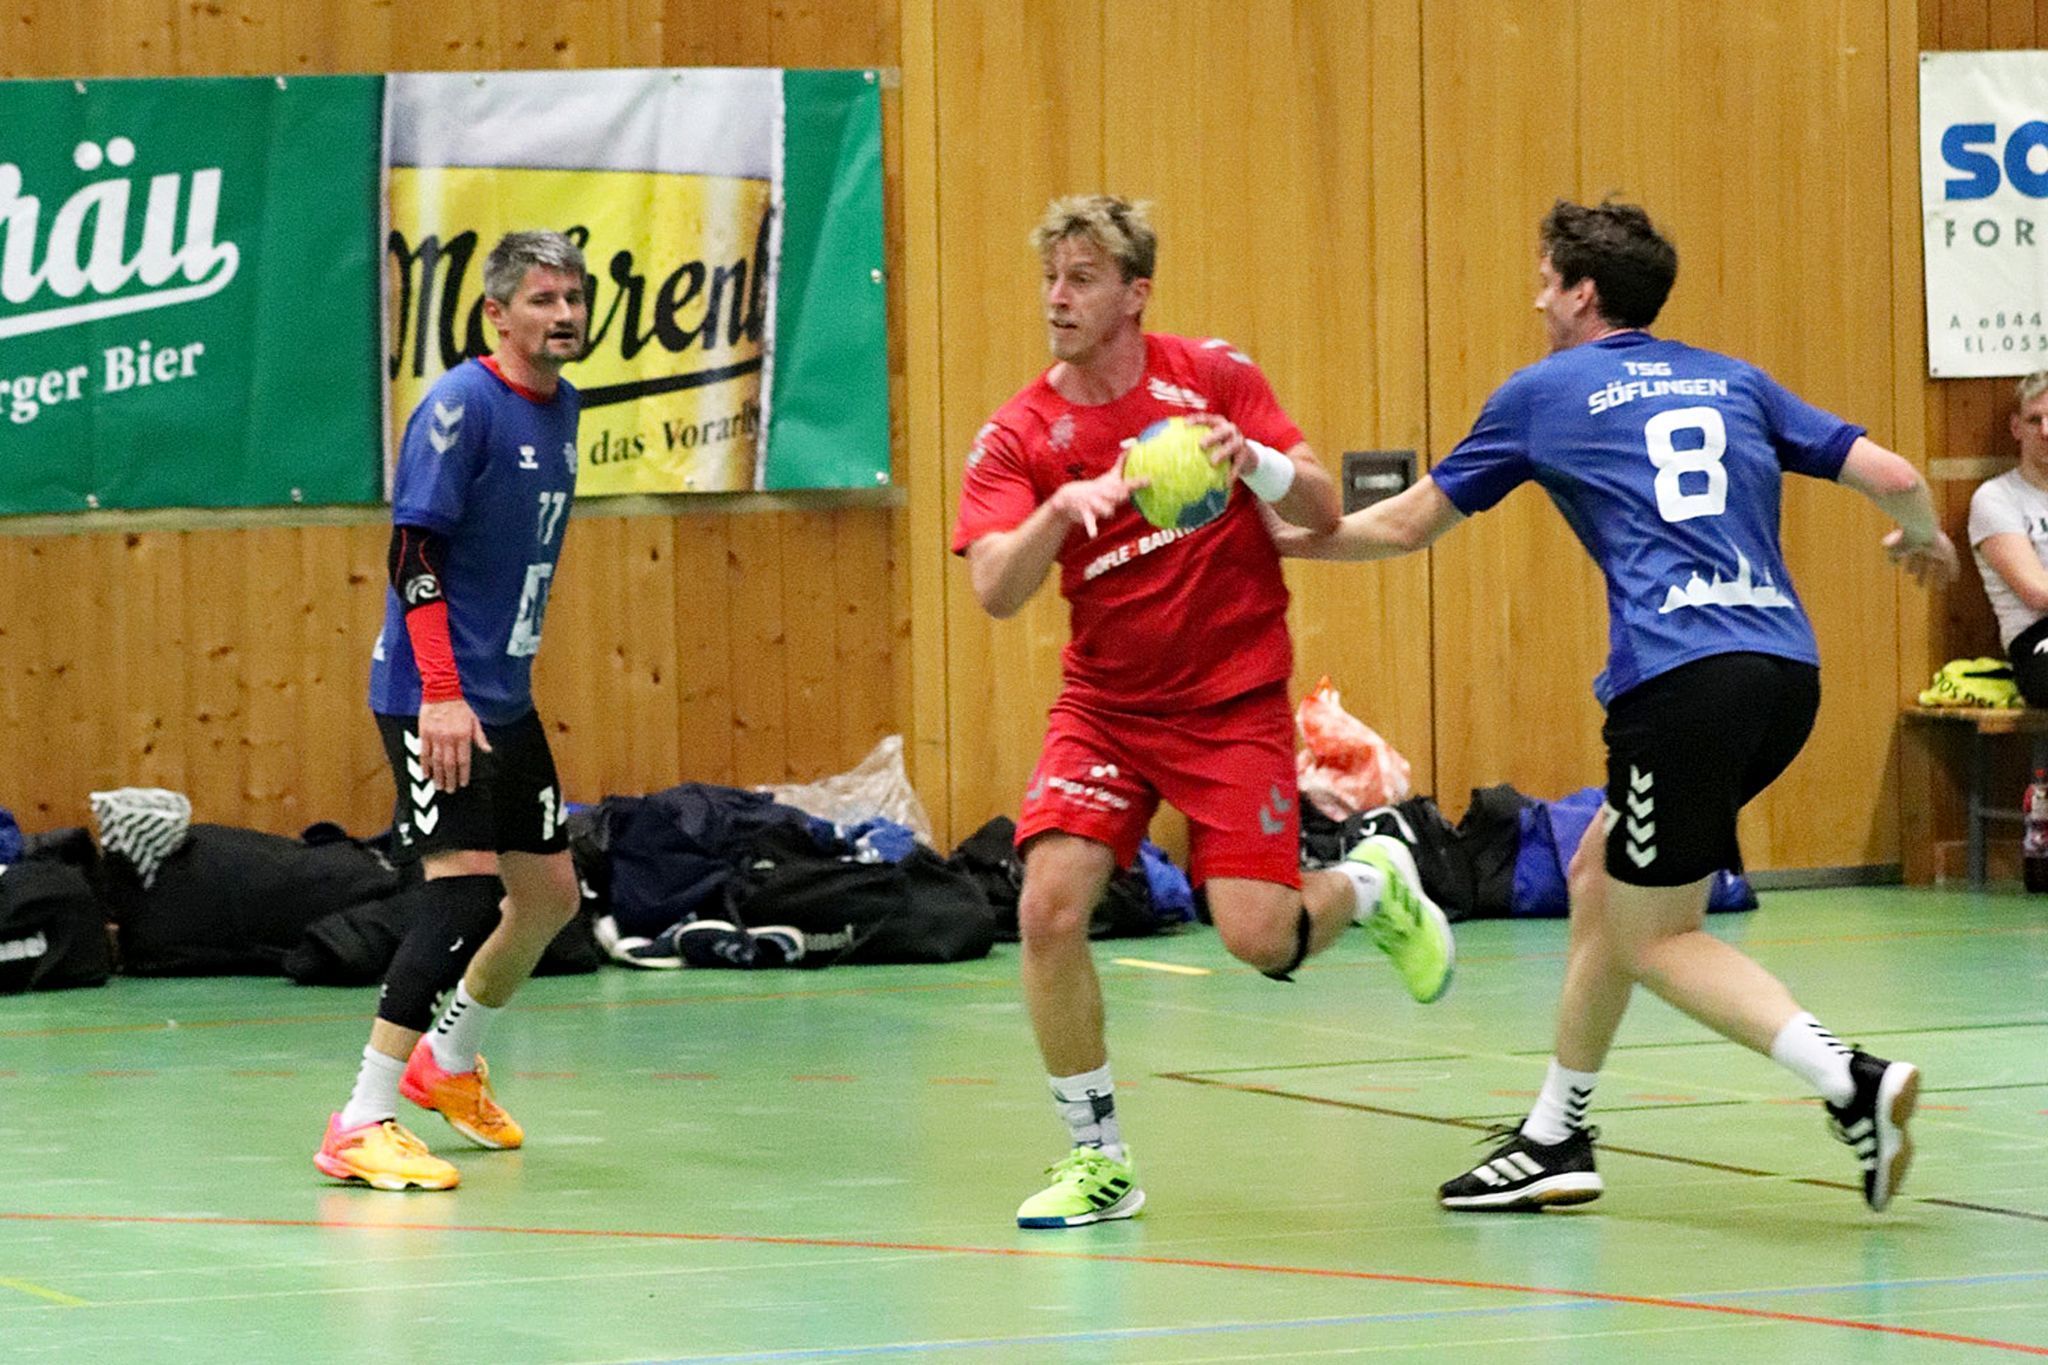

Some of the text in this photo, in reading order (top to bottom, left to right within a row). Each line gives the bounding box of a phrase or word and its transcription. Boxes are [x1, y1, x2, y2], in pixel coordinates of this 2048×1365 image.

[103, 339, 205, 393] Bier
[1621, 362, 1673, 376] TSG
[1588, 379, 1728, 415] SÖFLINGEN
[590, 429, 646, 466] das
[1644, 405, 1729, 523] 8
